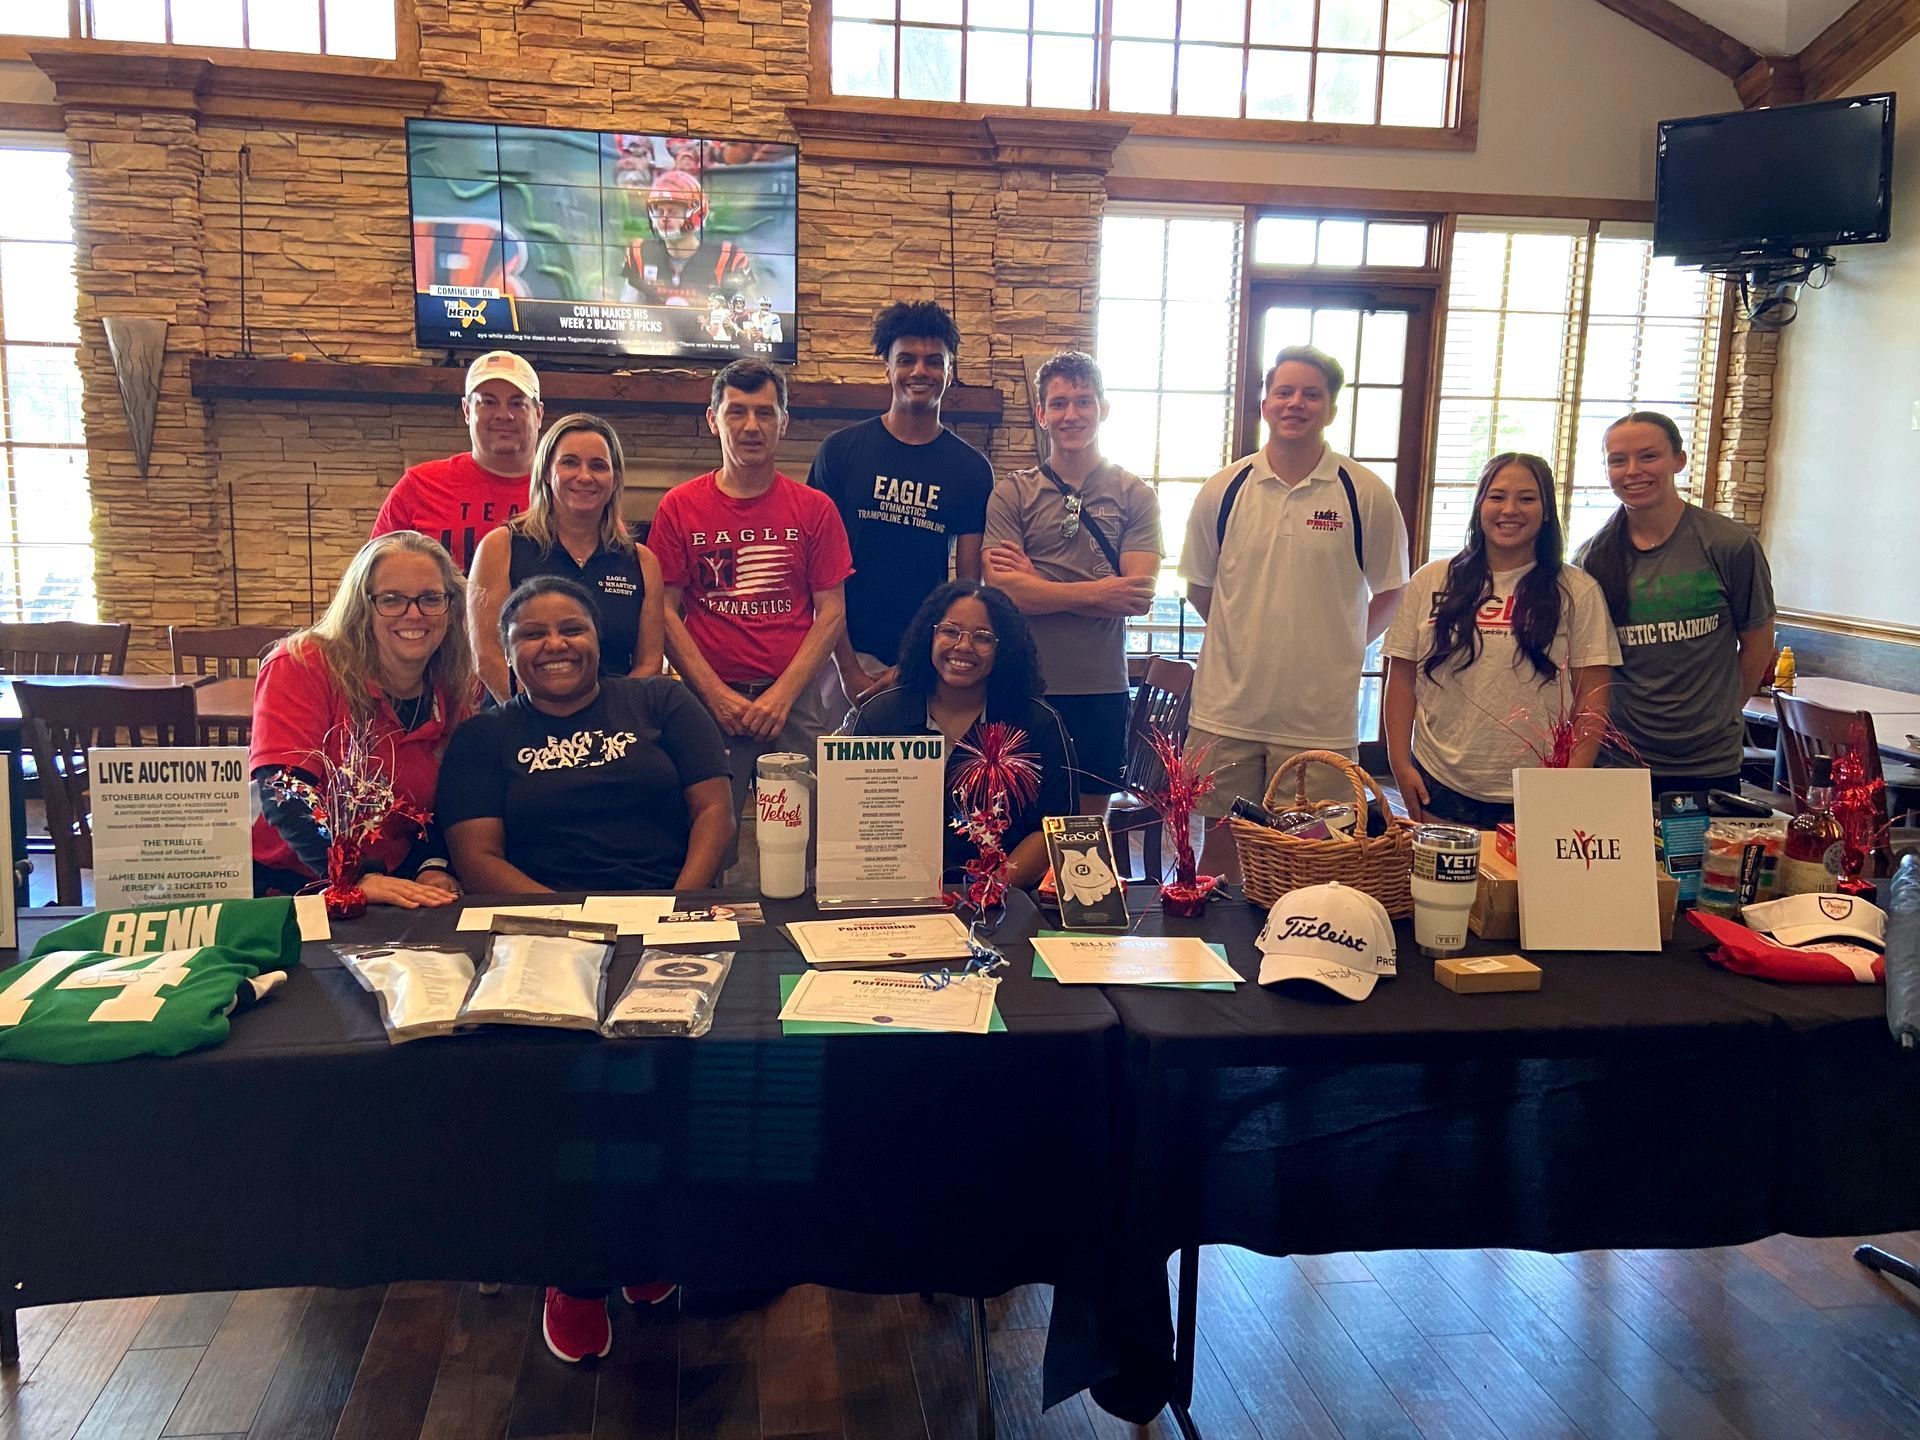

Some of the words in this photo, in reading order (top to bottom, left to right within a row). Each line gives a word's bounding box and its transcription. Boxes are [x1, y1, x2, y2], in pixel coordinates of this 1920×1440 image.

[437, 287, 468, 296] COMING
[470, 288, 481, 296] UP
[483, 288, 493, 297] ON
[448, 308, 480, 318] HERD
[574, 306, 600, 319] COLIN
[601, 307, 632, 320] MAKES
[633, 309, 648, 320] HIS
[559, 317, 586, 330] WEEK
[587, 318, 594, 330] 2
[594, 318, 628, 331] BLAZIN'
[629, 320, 636, 331] 5
[637, 320, 663, 333] PICKS
[753, 343, 773, 353] FS1
[874, 475, 941, 510] EAGLE
[460, 502, 520, 522] TEA
[879, 501, 927, 518] GYMNASTICS
[857, 509, 902, 524] TRAMPOLINE
[903, 517, 910, 525] &
[912, 517, 945, 534] TUMBLING
[691, 528, 799, 546] EAGLE
[598, 580, 637, 590] GMNASTICS
[604, 587, 633, 596] ACADEMY
[1657, 613, 1719, 643] TRAINING
[824, 742, 896, 761] THANK
[900, 740, 943, 760] YOU
[98, 761, 134, 784] LIVE
[138, 760, 207, 783] AUCTION
[211, 760, 243, 782] 7:00
[101, 792, 163, 802] STONEBRIAR
[165, 792, 212, 801] COUNTRY
[214, 791, 240, 799] CLUB
[759, 803, 802, 822] Velvet
[785, 820, 802, 828] Eagle
[142, 839, 161, 847] THE
[164, 838, 203, 847] TRIBUTE
[1053, 831, 1100, 842] StaSof
[1555, 838, 1621, 860] EAGLE
[1441, 854, 1477, 869] YETI
[108, 873, 136, 881] JAMIE
[137, 872, 165, 880] BENN
[167, 870, 240, 880] AUTOGRAPHED
[121, 884, 155, 893] JERSEY
[174, 882, 214, 891] TICKETS
[215, 881, 228, 889] TO
[103, 903, 223, 957] BENN
[838, 924, 916, 932] Performance
[1277, 915, 1368, 952] Titleist
[1438, 936, 1459, 944] YETI
[1376, 956, 1397, 967] PRO
[0, 946, 204, 1027] 14
